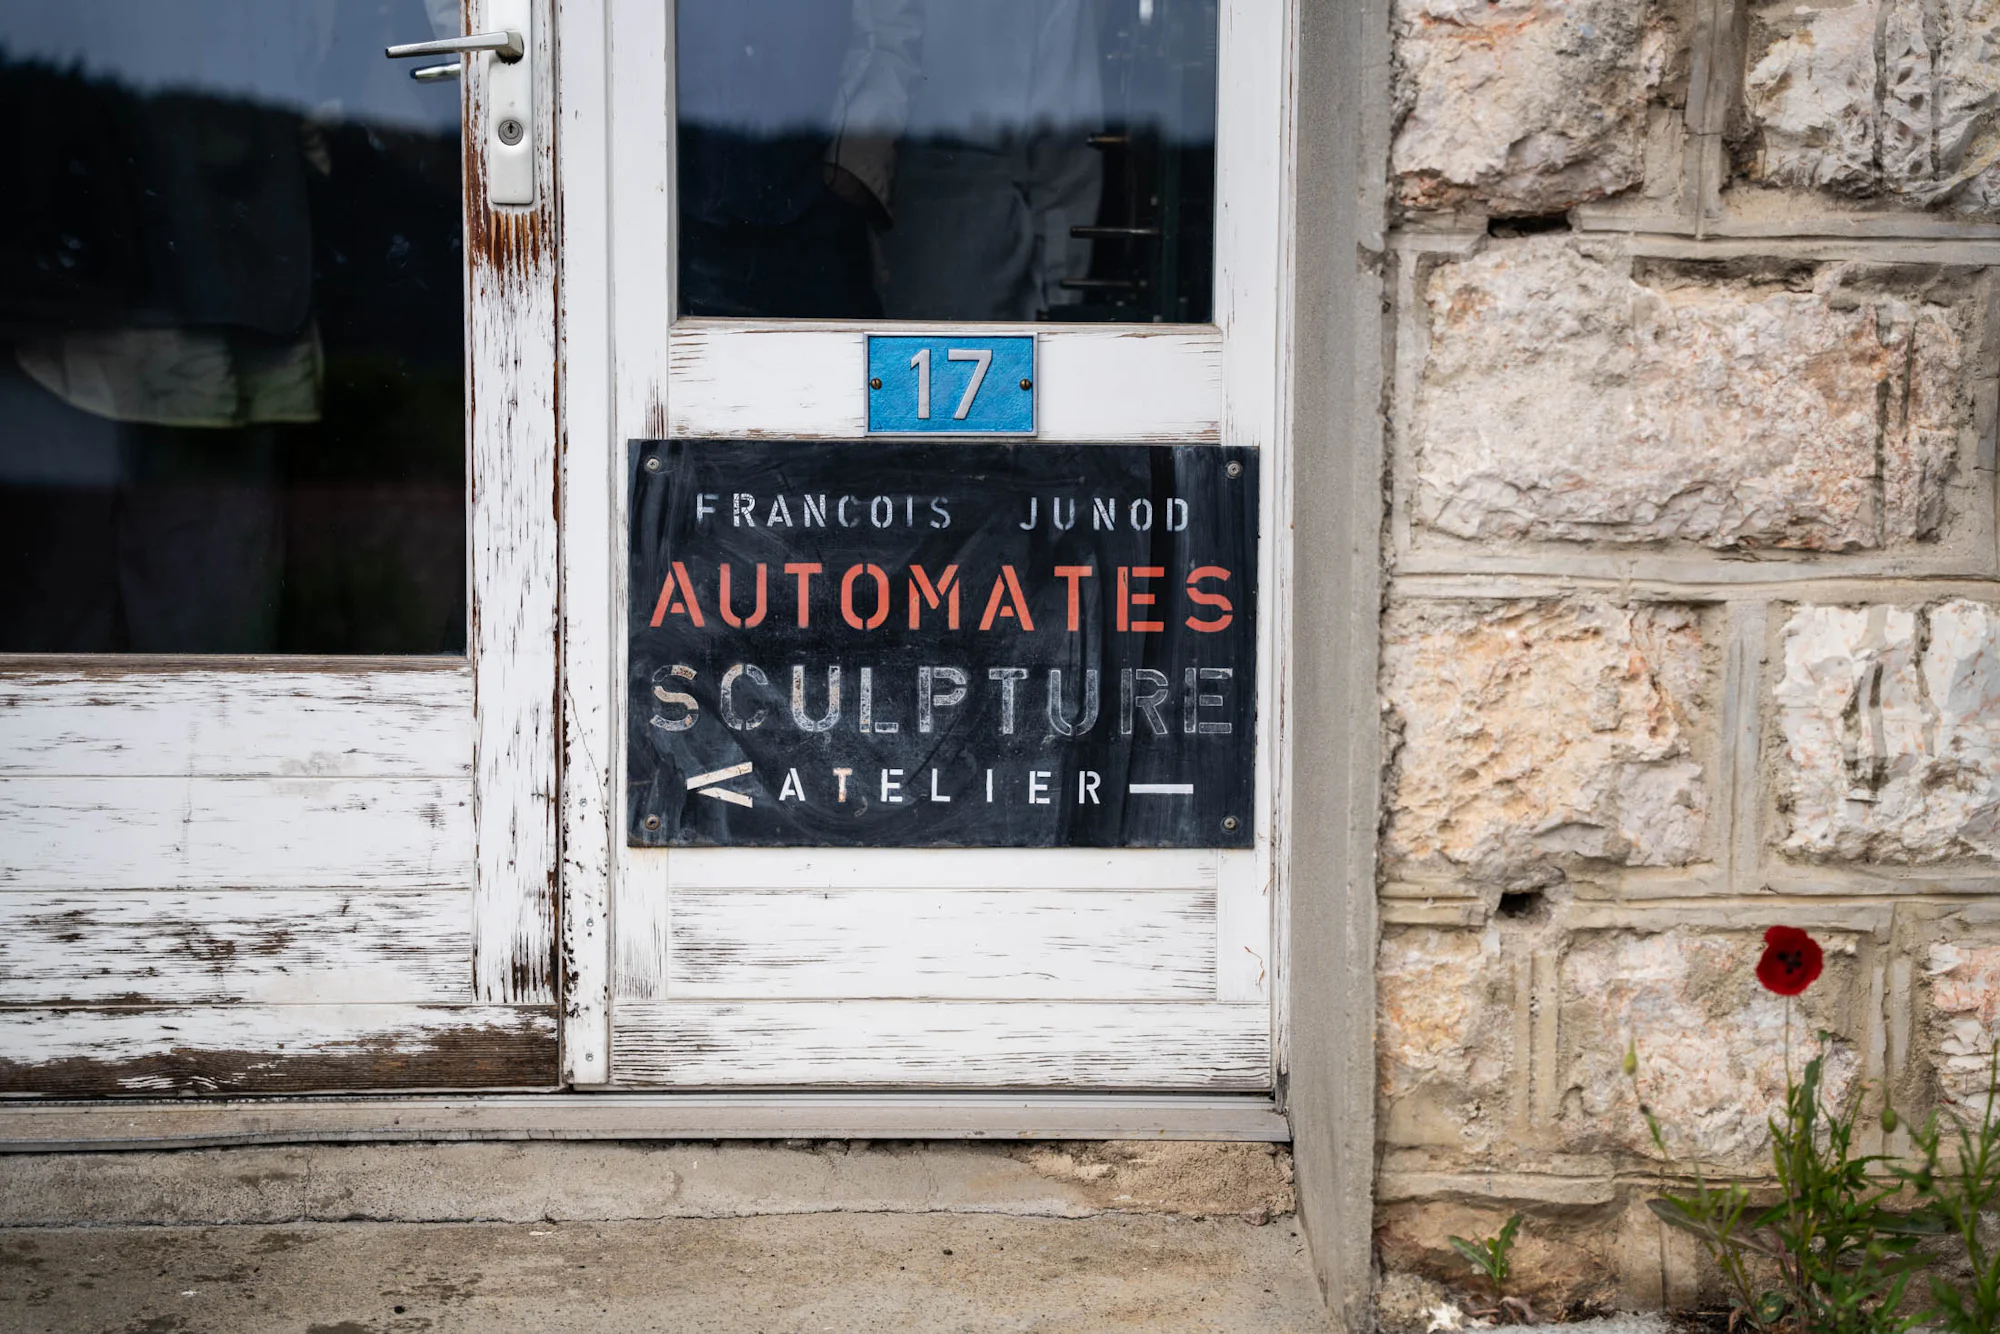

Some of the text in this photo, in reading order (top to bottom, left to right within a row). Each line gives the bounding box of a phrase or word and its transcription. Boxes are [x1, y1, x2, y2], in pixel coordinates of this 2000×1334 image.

[910, 348, 993, 420] 17
[696, 492, 1189, 532] FRANCOIS JUNOD
[649, 561, 1234, 633] AUTOMATES
[649, 663, 1233, 737] SCULPTURE
[778, 767, 1101, 804] ATELIER
